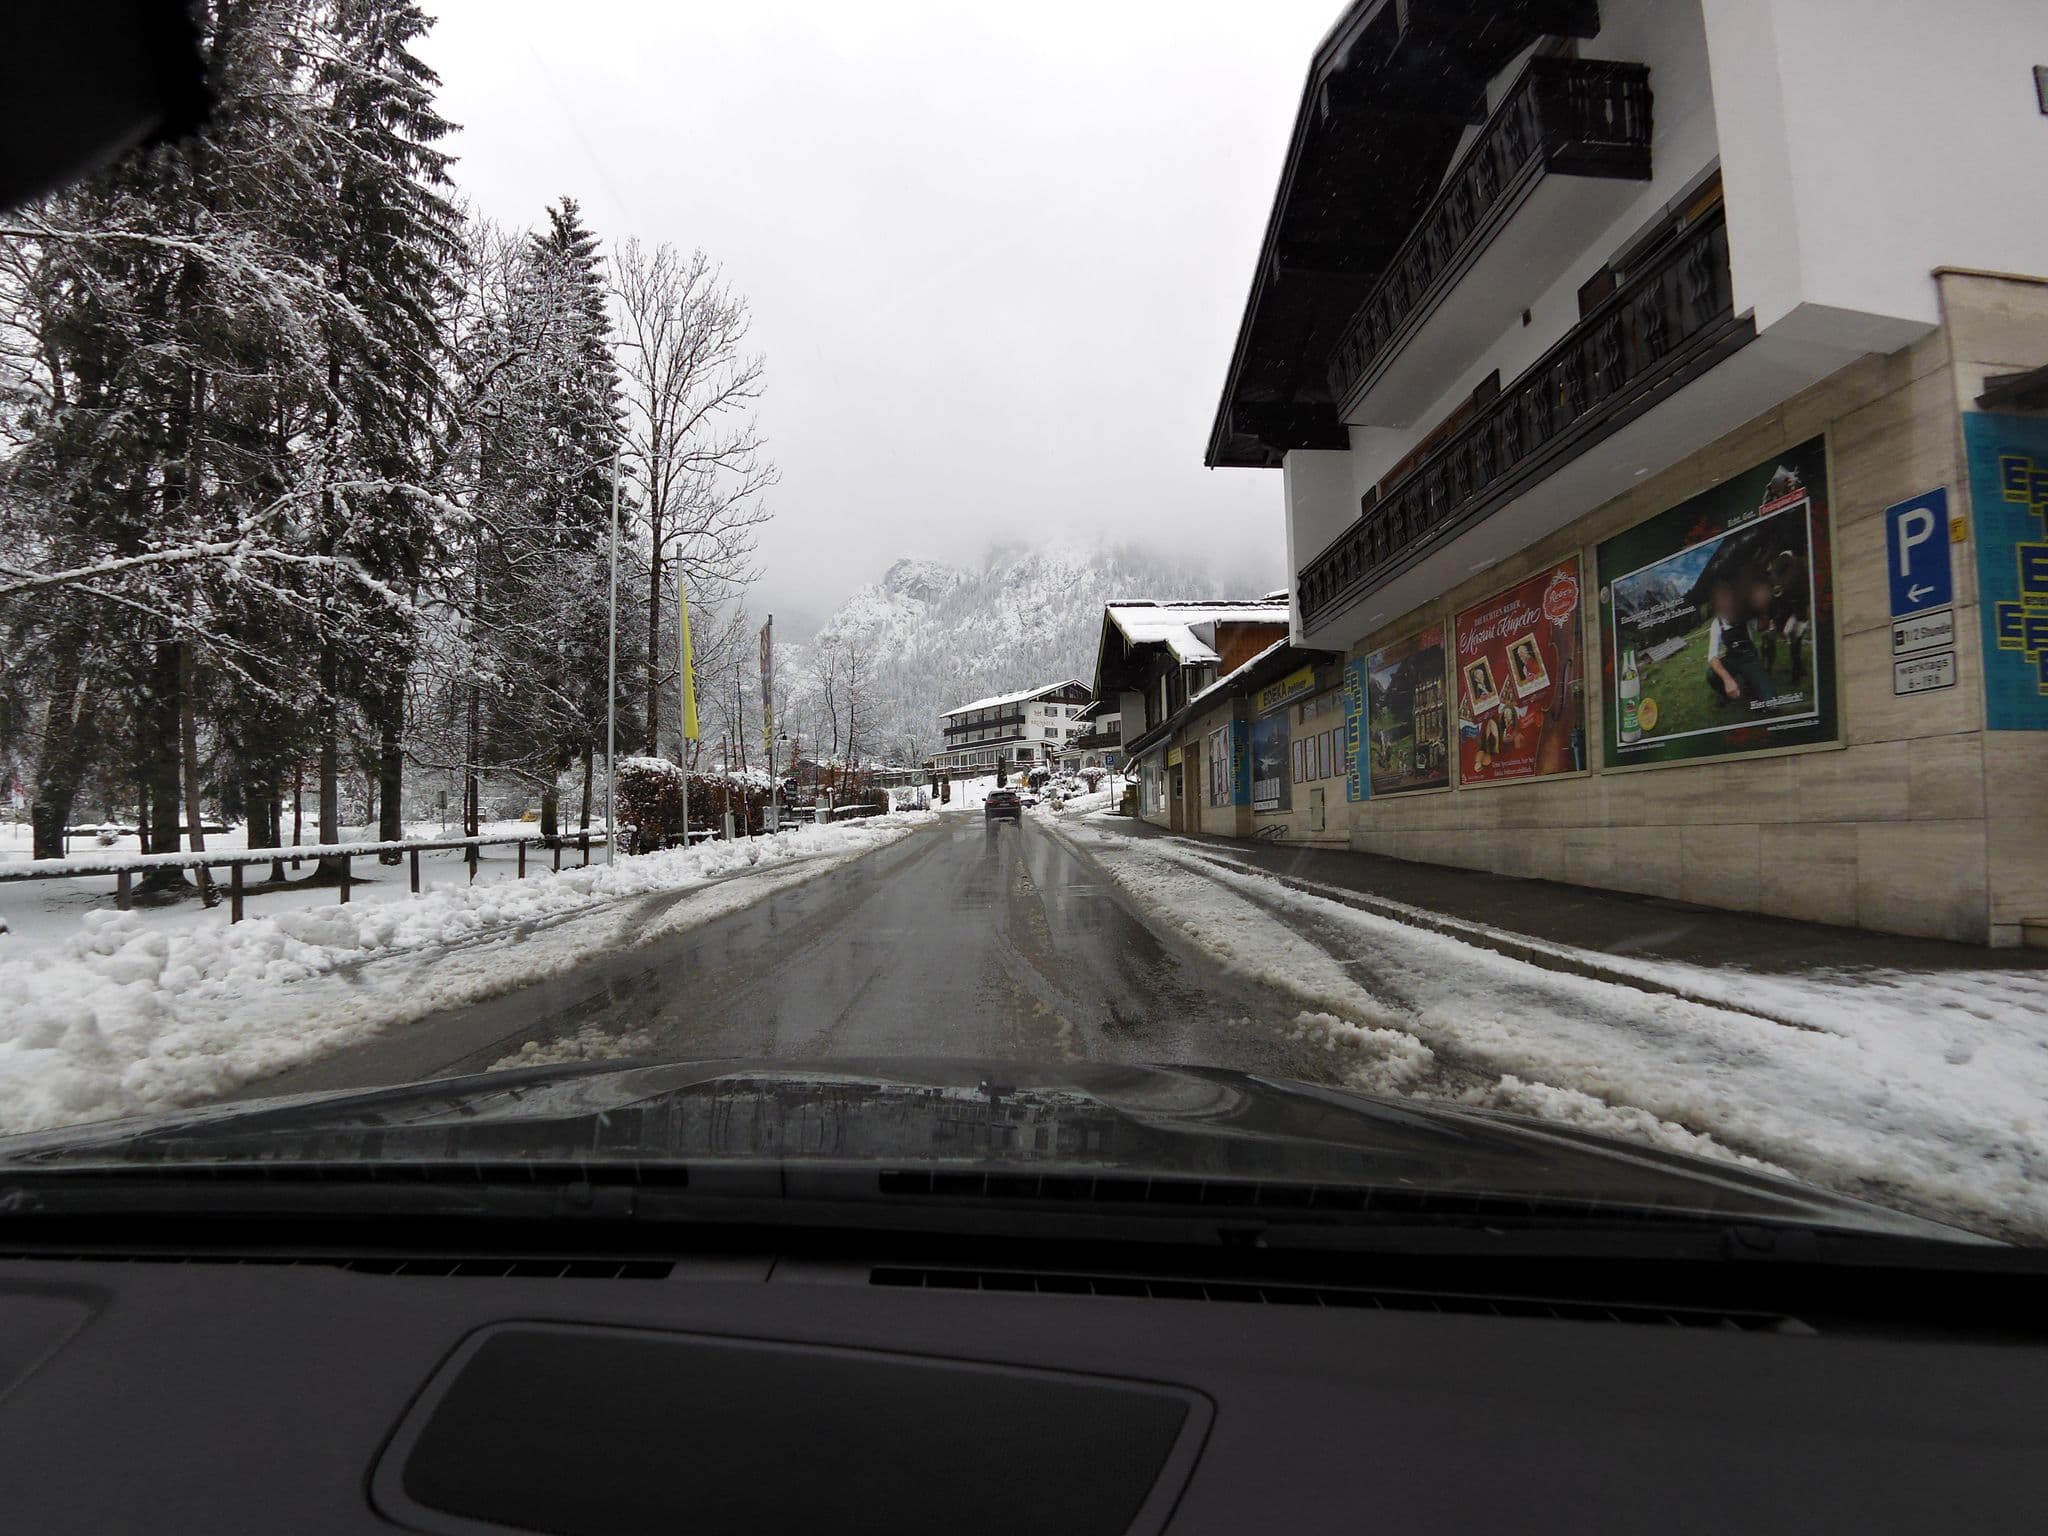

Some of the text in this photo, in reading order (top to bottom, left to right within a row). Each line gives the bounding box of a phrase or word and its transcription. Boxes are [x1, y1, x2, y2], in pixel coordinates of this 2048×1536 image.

[1898, 508, 1934, 576] P
[1920, 622, 1953, 640] Stunde
[1899, 659, 1949, 676] werktags
[1263, 681, 1289, 707] EDEKA
